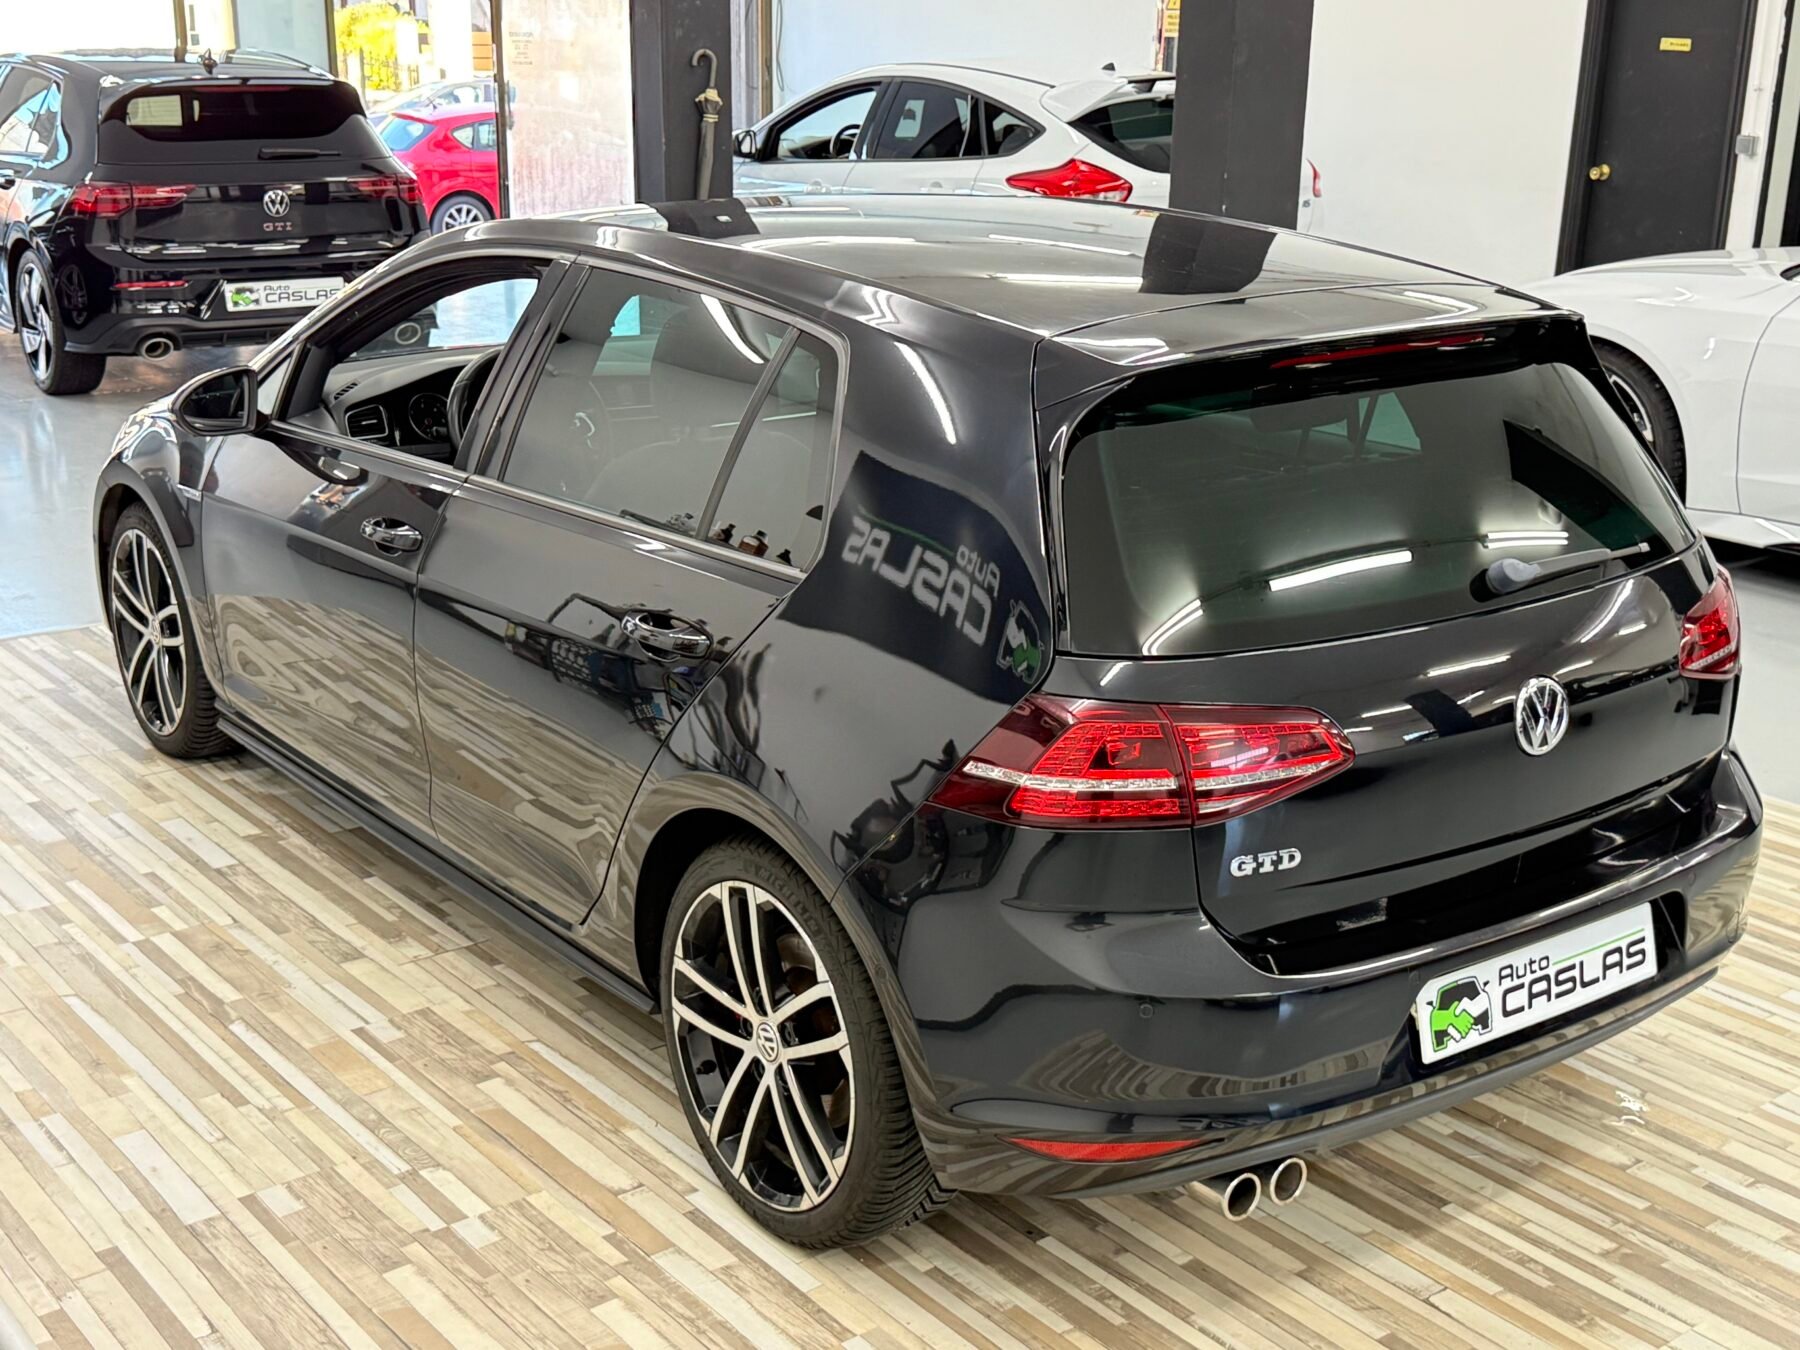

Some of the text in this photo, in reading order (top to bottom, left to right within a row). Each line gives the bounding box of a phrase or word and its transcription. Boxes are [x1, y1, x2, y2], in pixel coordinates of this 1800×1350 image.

[263, 222, 292, 232] GTI
[1230, 847, 1302, 877] GTD
[1499, 955, 1550, 986] Auto
[1502, 936, 1646, 1018] CASLAS
